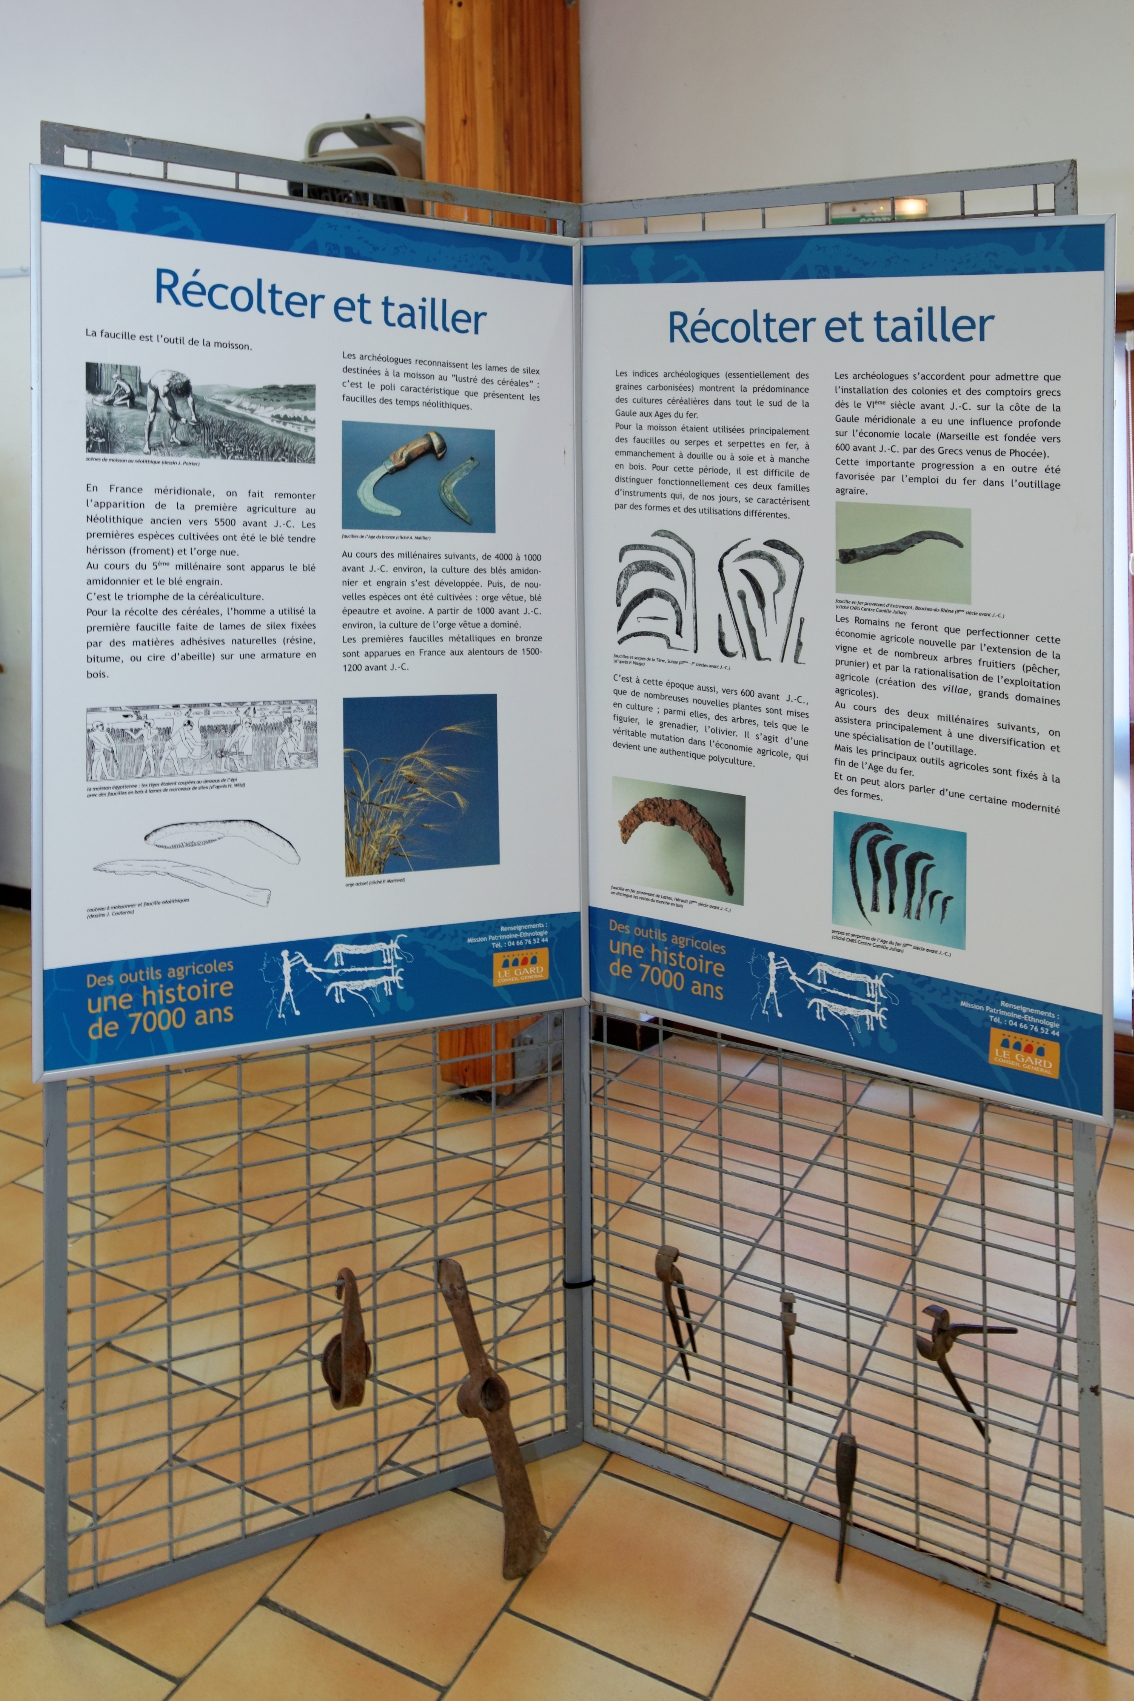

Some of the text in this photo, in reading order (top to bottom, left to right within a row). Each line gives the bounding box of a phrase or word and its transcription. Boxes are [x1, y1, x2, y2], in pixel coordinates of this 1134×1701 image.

[155, 267, 487, 335] Récolter et tailler
[669, 306, 995, 343] Récolter et tailler
[86, 328, 252, 350] La faucille est l'outil de la moisson.
[342, 351, 540, 375] Les archéologues reconnaissent les lames de silex
[632, 370, 658, 378] indices
[663, 370, 720, 380] archéologiques
[725, 371, 790, 380] (essentiellement
[796, 371, 809, 380] des
[834, 371, 1061, 383] Les archéologues s'accordent pour admettre que
[616, 383, 642, 392] graines
[646, 383, 694, 393] carbonisées)
[740, 384, 748, 392] la
[752, 384, 810, 394] prédominance
[835, 386, 1061, 398] l'installation des colonies et des comptoirs grecs
[835, 457, 859, 466] Cette
[866, 459, 916, 468] importante
[922, 462, 974, 472] progression
[1011, 464, 1038, 474] outre
[1044, 464, 1061, 474] été
[86, 484, 98, 492] En
[110, 484, 143, 494] France
[154, 486, 215, 498] méridionale,
[248, 490, 264, 498] fait
[274, 492, 316, 500] remonter
[86, 498, 145, 510] l'apparition
[154, 501, 166, 510] de
[176, 501, 185, 510] la
[194, 502, 238, 512] première
[246, 504, 296, 514] agriculture
[86, 514, 144, 526] Néolithique
[150, 516, 182, 526] ancien
[214, 517, 236, 527] 5500
[242, 520, 267, 528] avant
[274, 520, 294, 528] J.-C.
[302, 520, 316, 528] Les
[836, 614, 850, 624] Les
[854, 616, 890, 628] Romains
[911, 622, 939, 632] feront
[944, 626, 961, 635] que
[966, 628, 1030, 641] perfectionner
[1035, 636, 1061, 644] cette
[342, 636, 356, 644] Les
[362, 634, 404, 645] premières
[409, 634, 444, 642] faucilles
[448, 634, 496, 644] métalliques
[516, 634, 542, 642] bronze
[342, 650, 360, 658] sont
[364, 650, 401, 659] apparues
[419, 648, 446, 656] France
[468, 648, 504, 656] alentours
[508, 648, 518, 656] de
[522, 648, 542, 656] 1500-
[613, 688, 810, 718] que de nombreuses nouvelles plantes sont mises
[834, 716, 1060, 753] assistera principalement à une diversification et
[489, 930, 548, 941] Patrimoine-Ethnologie
[501, 923, 544, 931] Renseignements
[610, 919, 726, 955] Des outils agricoles
[610, 939, 725, 977] une histoire
[87, 960, 234, 988] Des outils agricoles
[498, 966, 544, 978] LE GARD
[610, 958, 724, 1001] de 7000 ans
[88, 979, 234, 1014] une histoire
[960, 1001, 1060, 1028] Mission Patrimoine-Ethnologie
[1000, 1001, 1055, 1018] Renseignements
[88, 1006, 234, 1040] de 7000 ans
[1020, 1022, 1028, 1030] 66
[1040, 1027, 1049, 1035] 52
[994, 1057, 1052, 1074] CONSEIL GENERAL
[995, 1049, 1052, 1069] LE GARD
